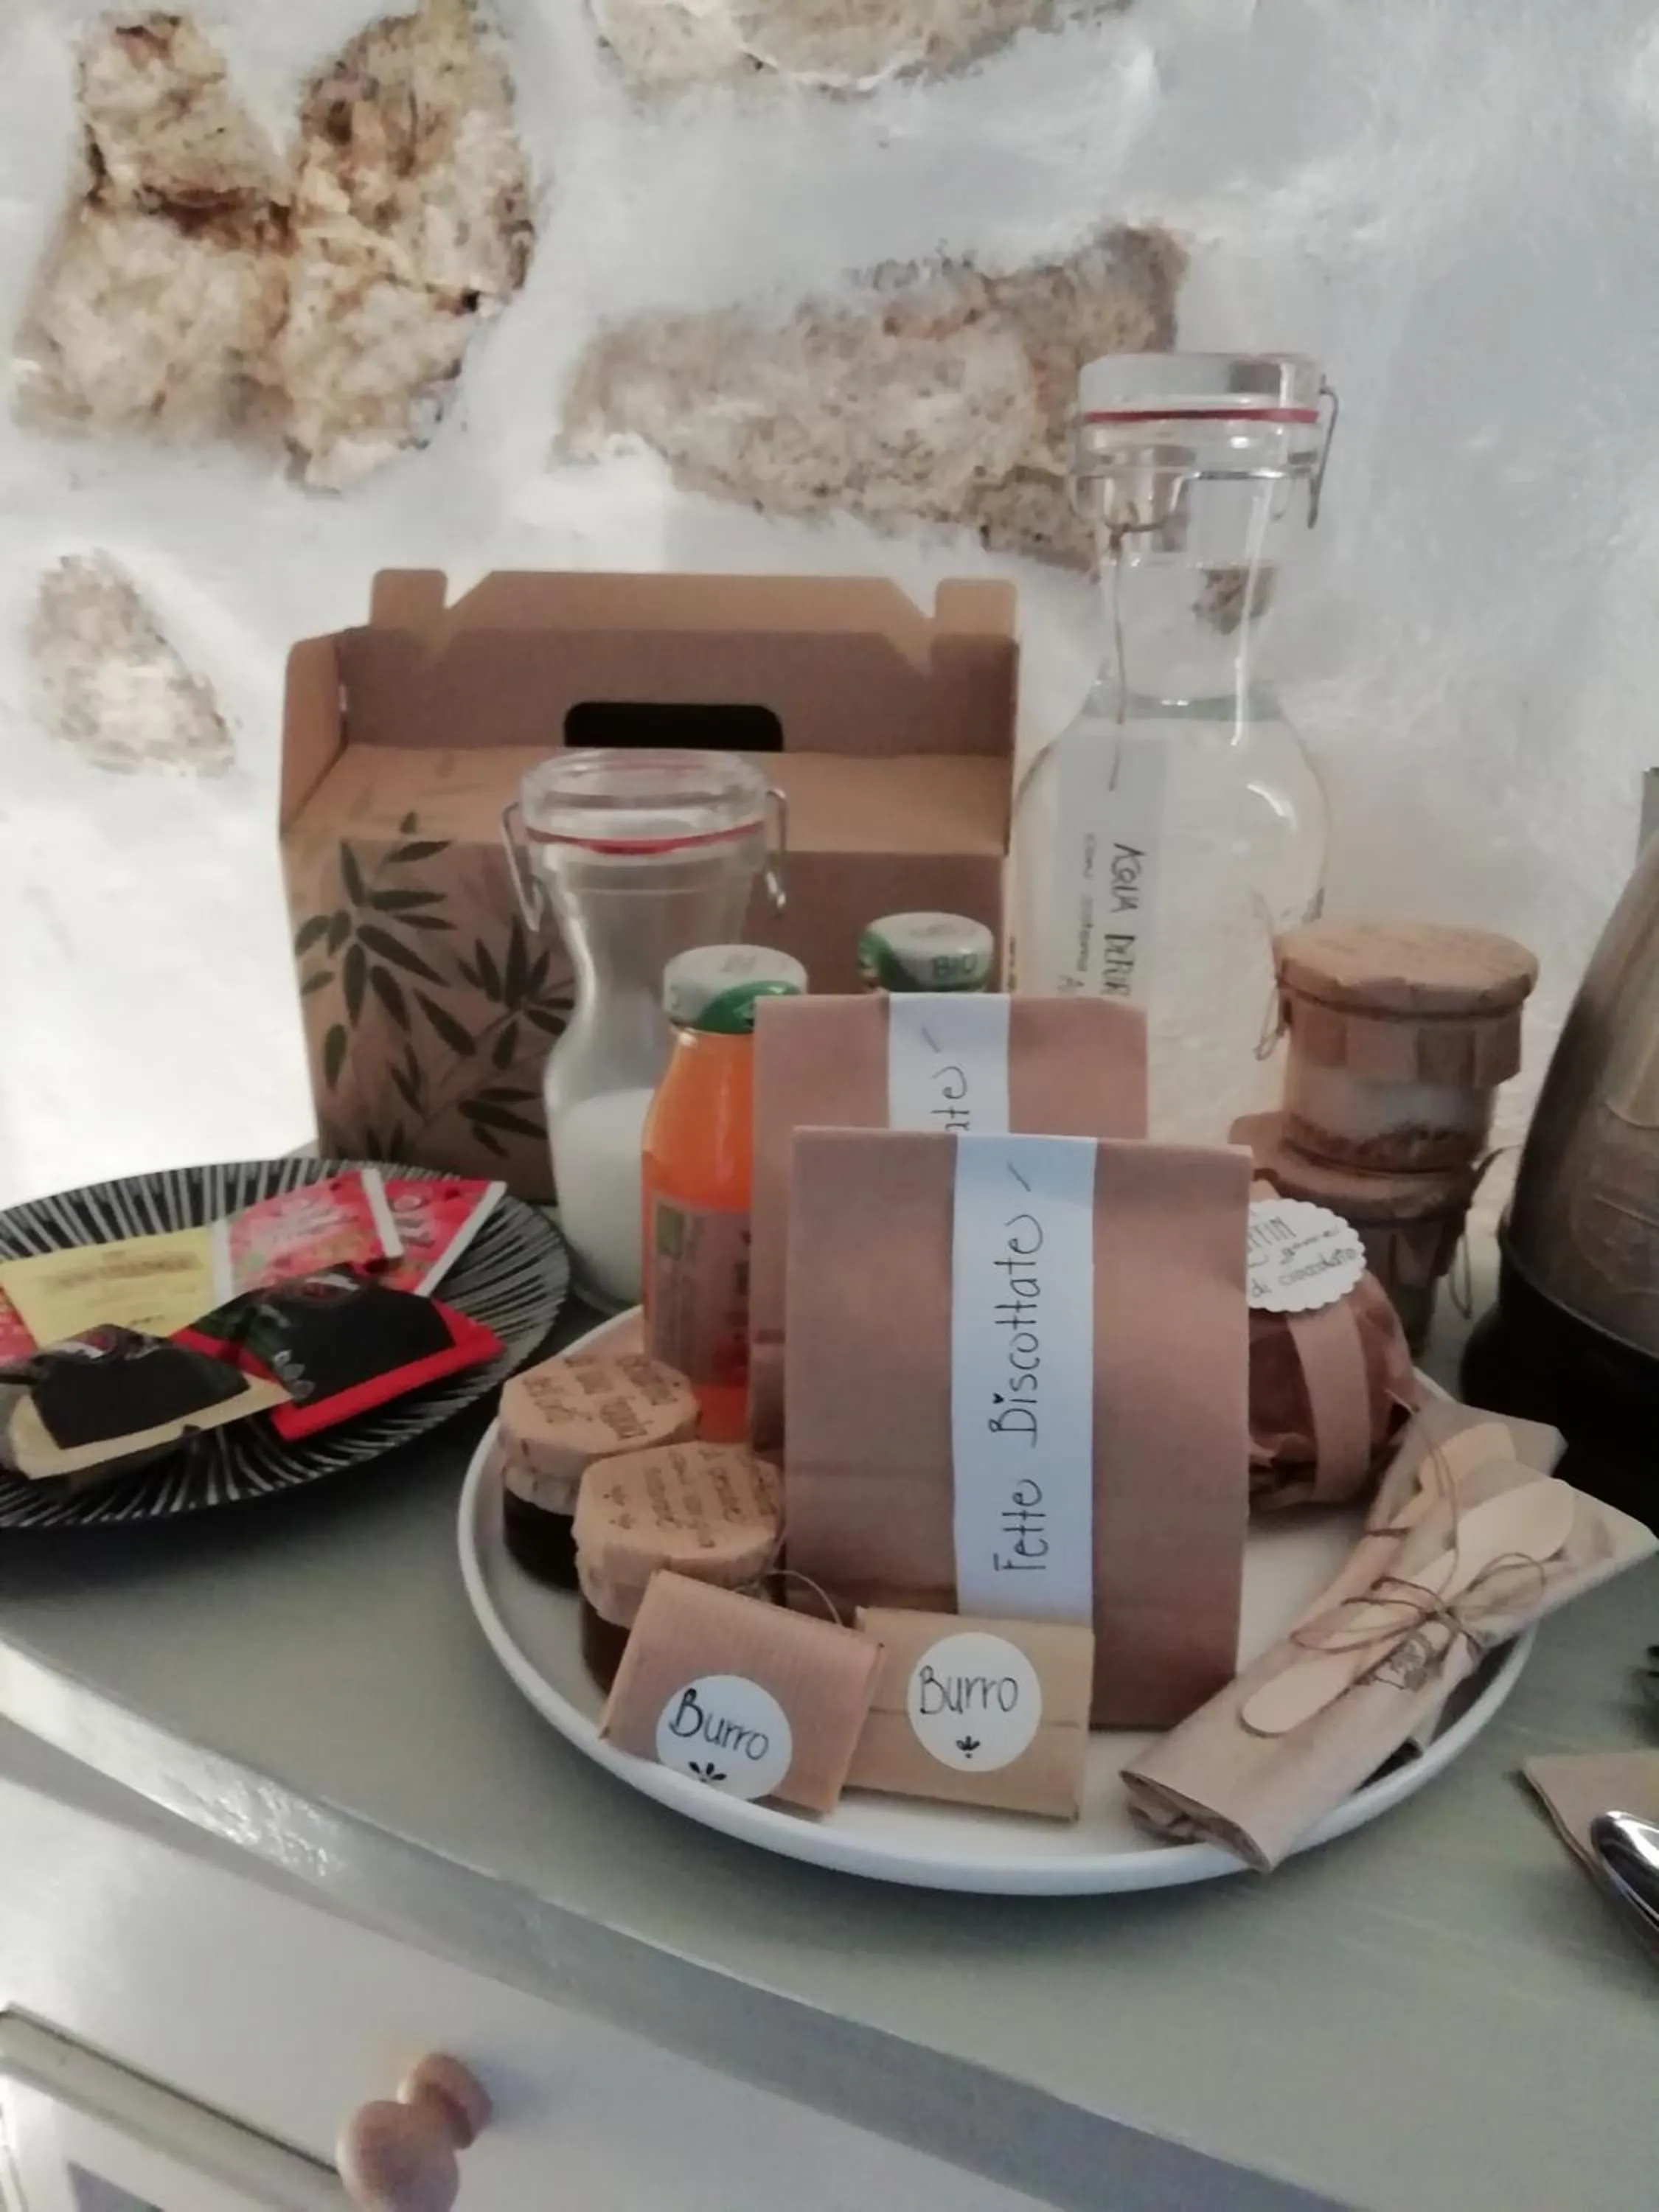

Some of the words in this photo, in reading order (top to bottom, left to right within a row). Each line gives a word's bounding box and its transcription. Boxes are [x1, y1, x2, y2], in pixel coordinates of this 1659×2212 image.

[988, 1214, 1043, 1447] Biscottate
[993, 1478, 1049, 1572] Fette
[668, 1688, 769, 1761] Burro
[919, 1665, 1019, 1716] Burro
